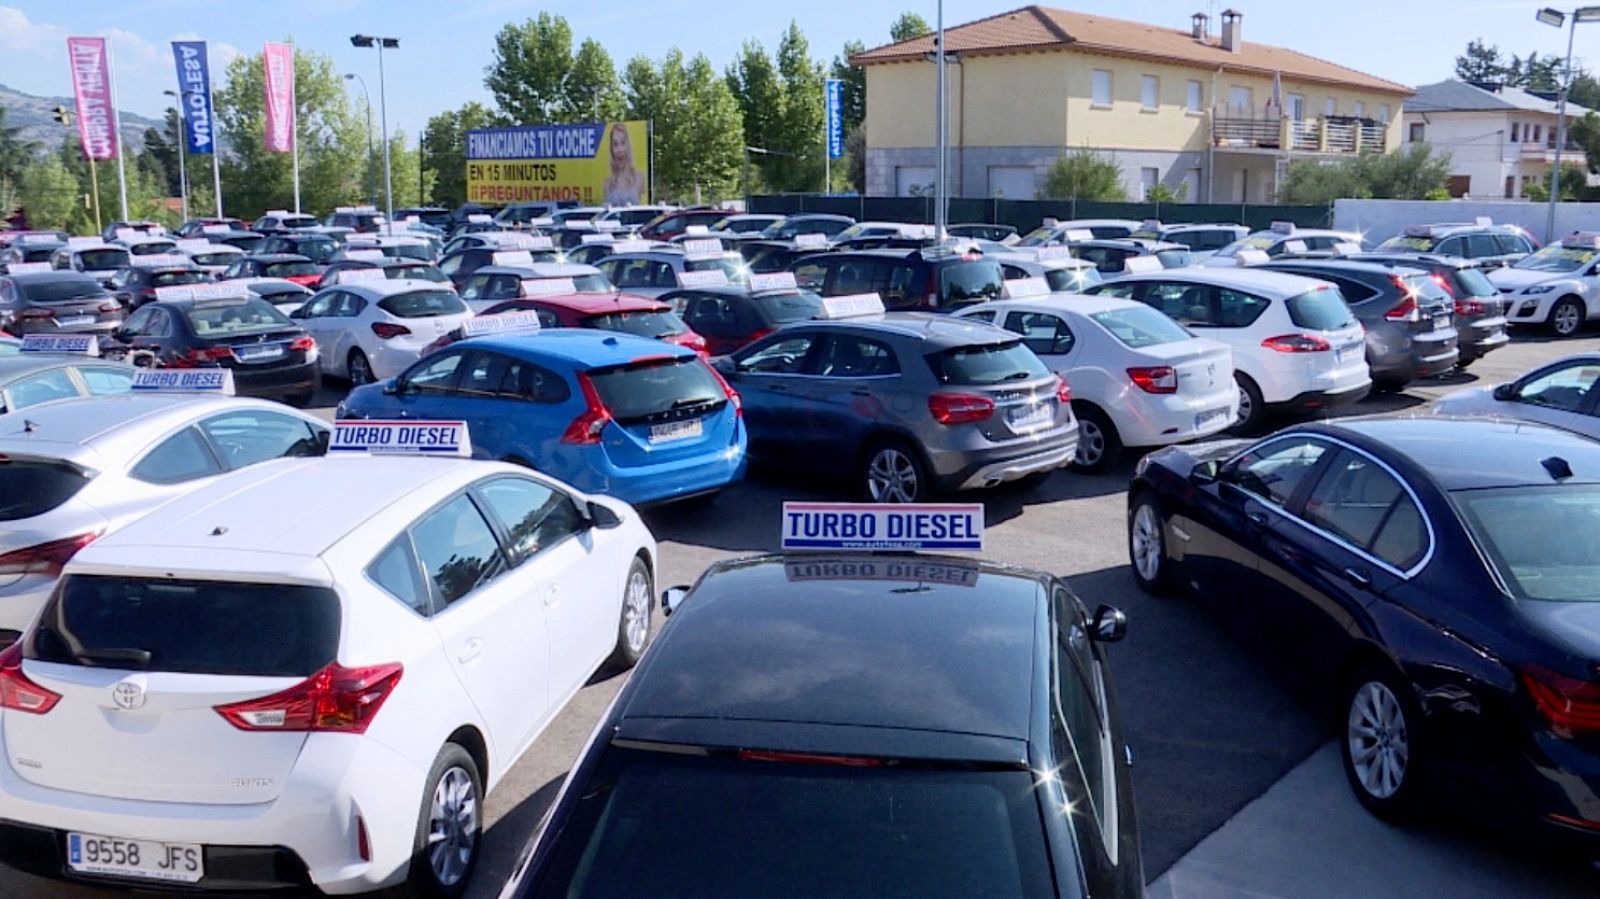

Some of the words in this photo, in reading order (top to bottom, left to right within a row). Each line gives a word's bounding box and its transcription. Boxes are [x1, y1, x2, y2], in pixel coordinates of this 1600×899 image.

[469, 131, 536, 158] FINANCIAMOS
[538, 131, 553, 156] TU
[556, 128, 595, 157] COCHE
[470, 165, 484, 181] EN
[487, 165, 500, 181] 15
[503, 163, 556, 181] MINUTOS
[23, 337, 56, 349] TURBO
[57, 337, 90, 349] DIESEL
[135, 373, 178, 386] TURBO
[181, 371, 224, 385] DIESEL
[335, 427, 393, 444] TURBO
[397, 427, 459, 445] DIESEL
[787, 512, 876, 538] TURBO
[887, 514, 979, 539] DIESEL
[85, 839, 141, 866] 9558
[158, 846, 198, 872] JFS
